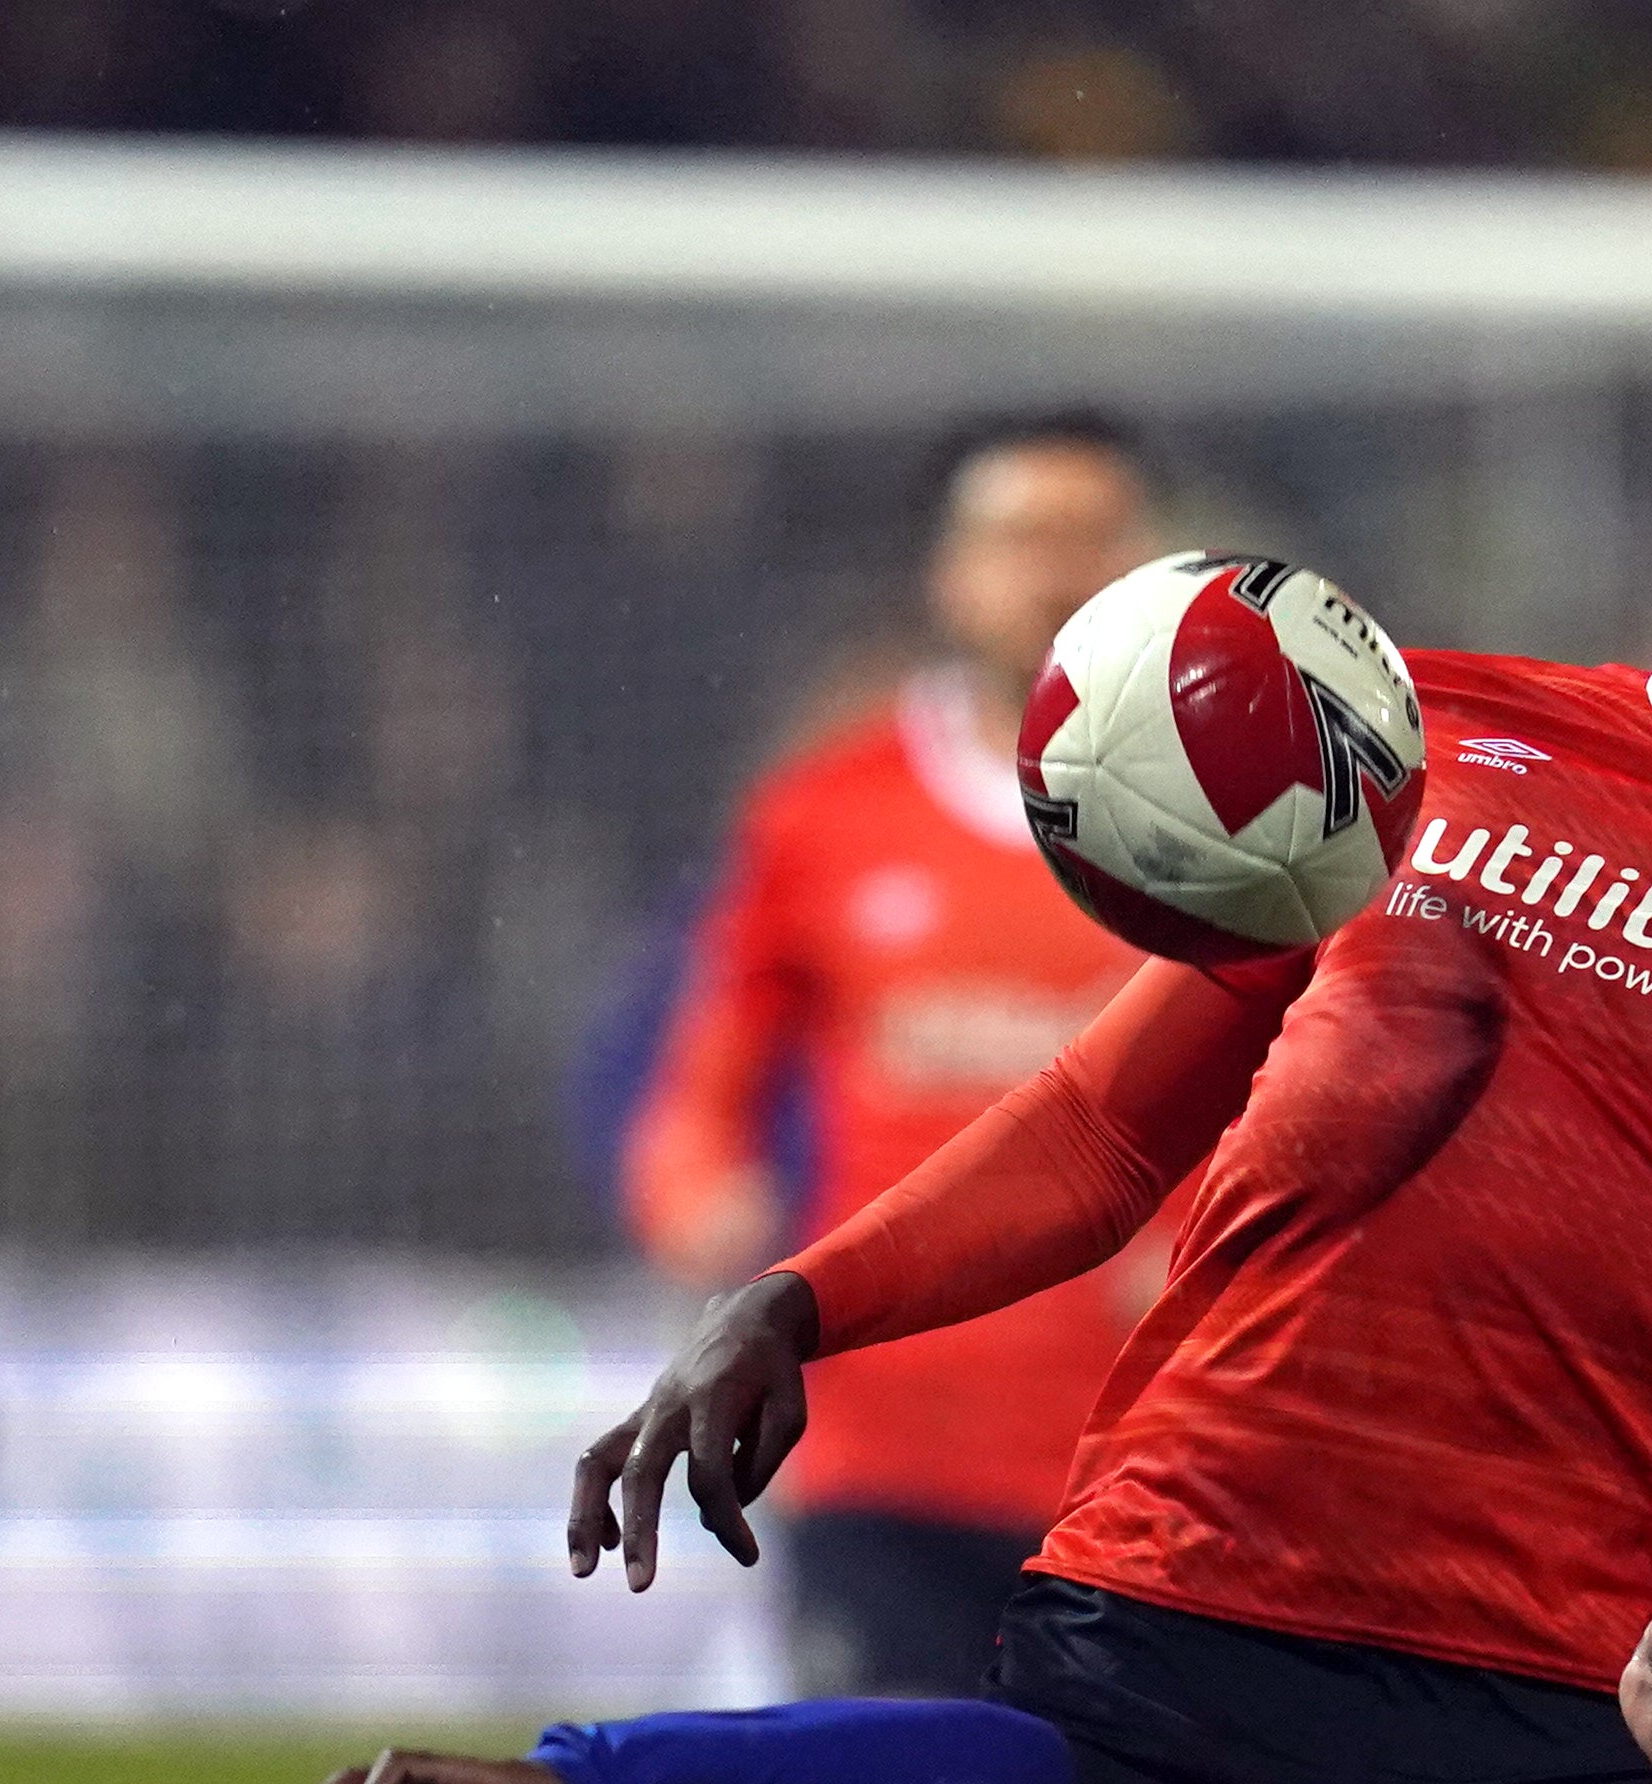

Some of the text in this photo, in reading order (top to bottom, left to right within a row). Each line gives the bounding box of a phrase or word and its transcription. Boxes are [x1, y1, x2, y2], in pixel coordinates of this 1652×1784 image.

[1457, 752, 1528, 775] umbro
[1385, 881, 1448, 920] life
[1462, 905, 1554, 958] with
